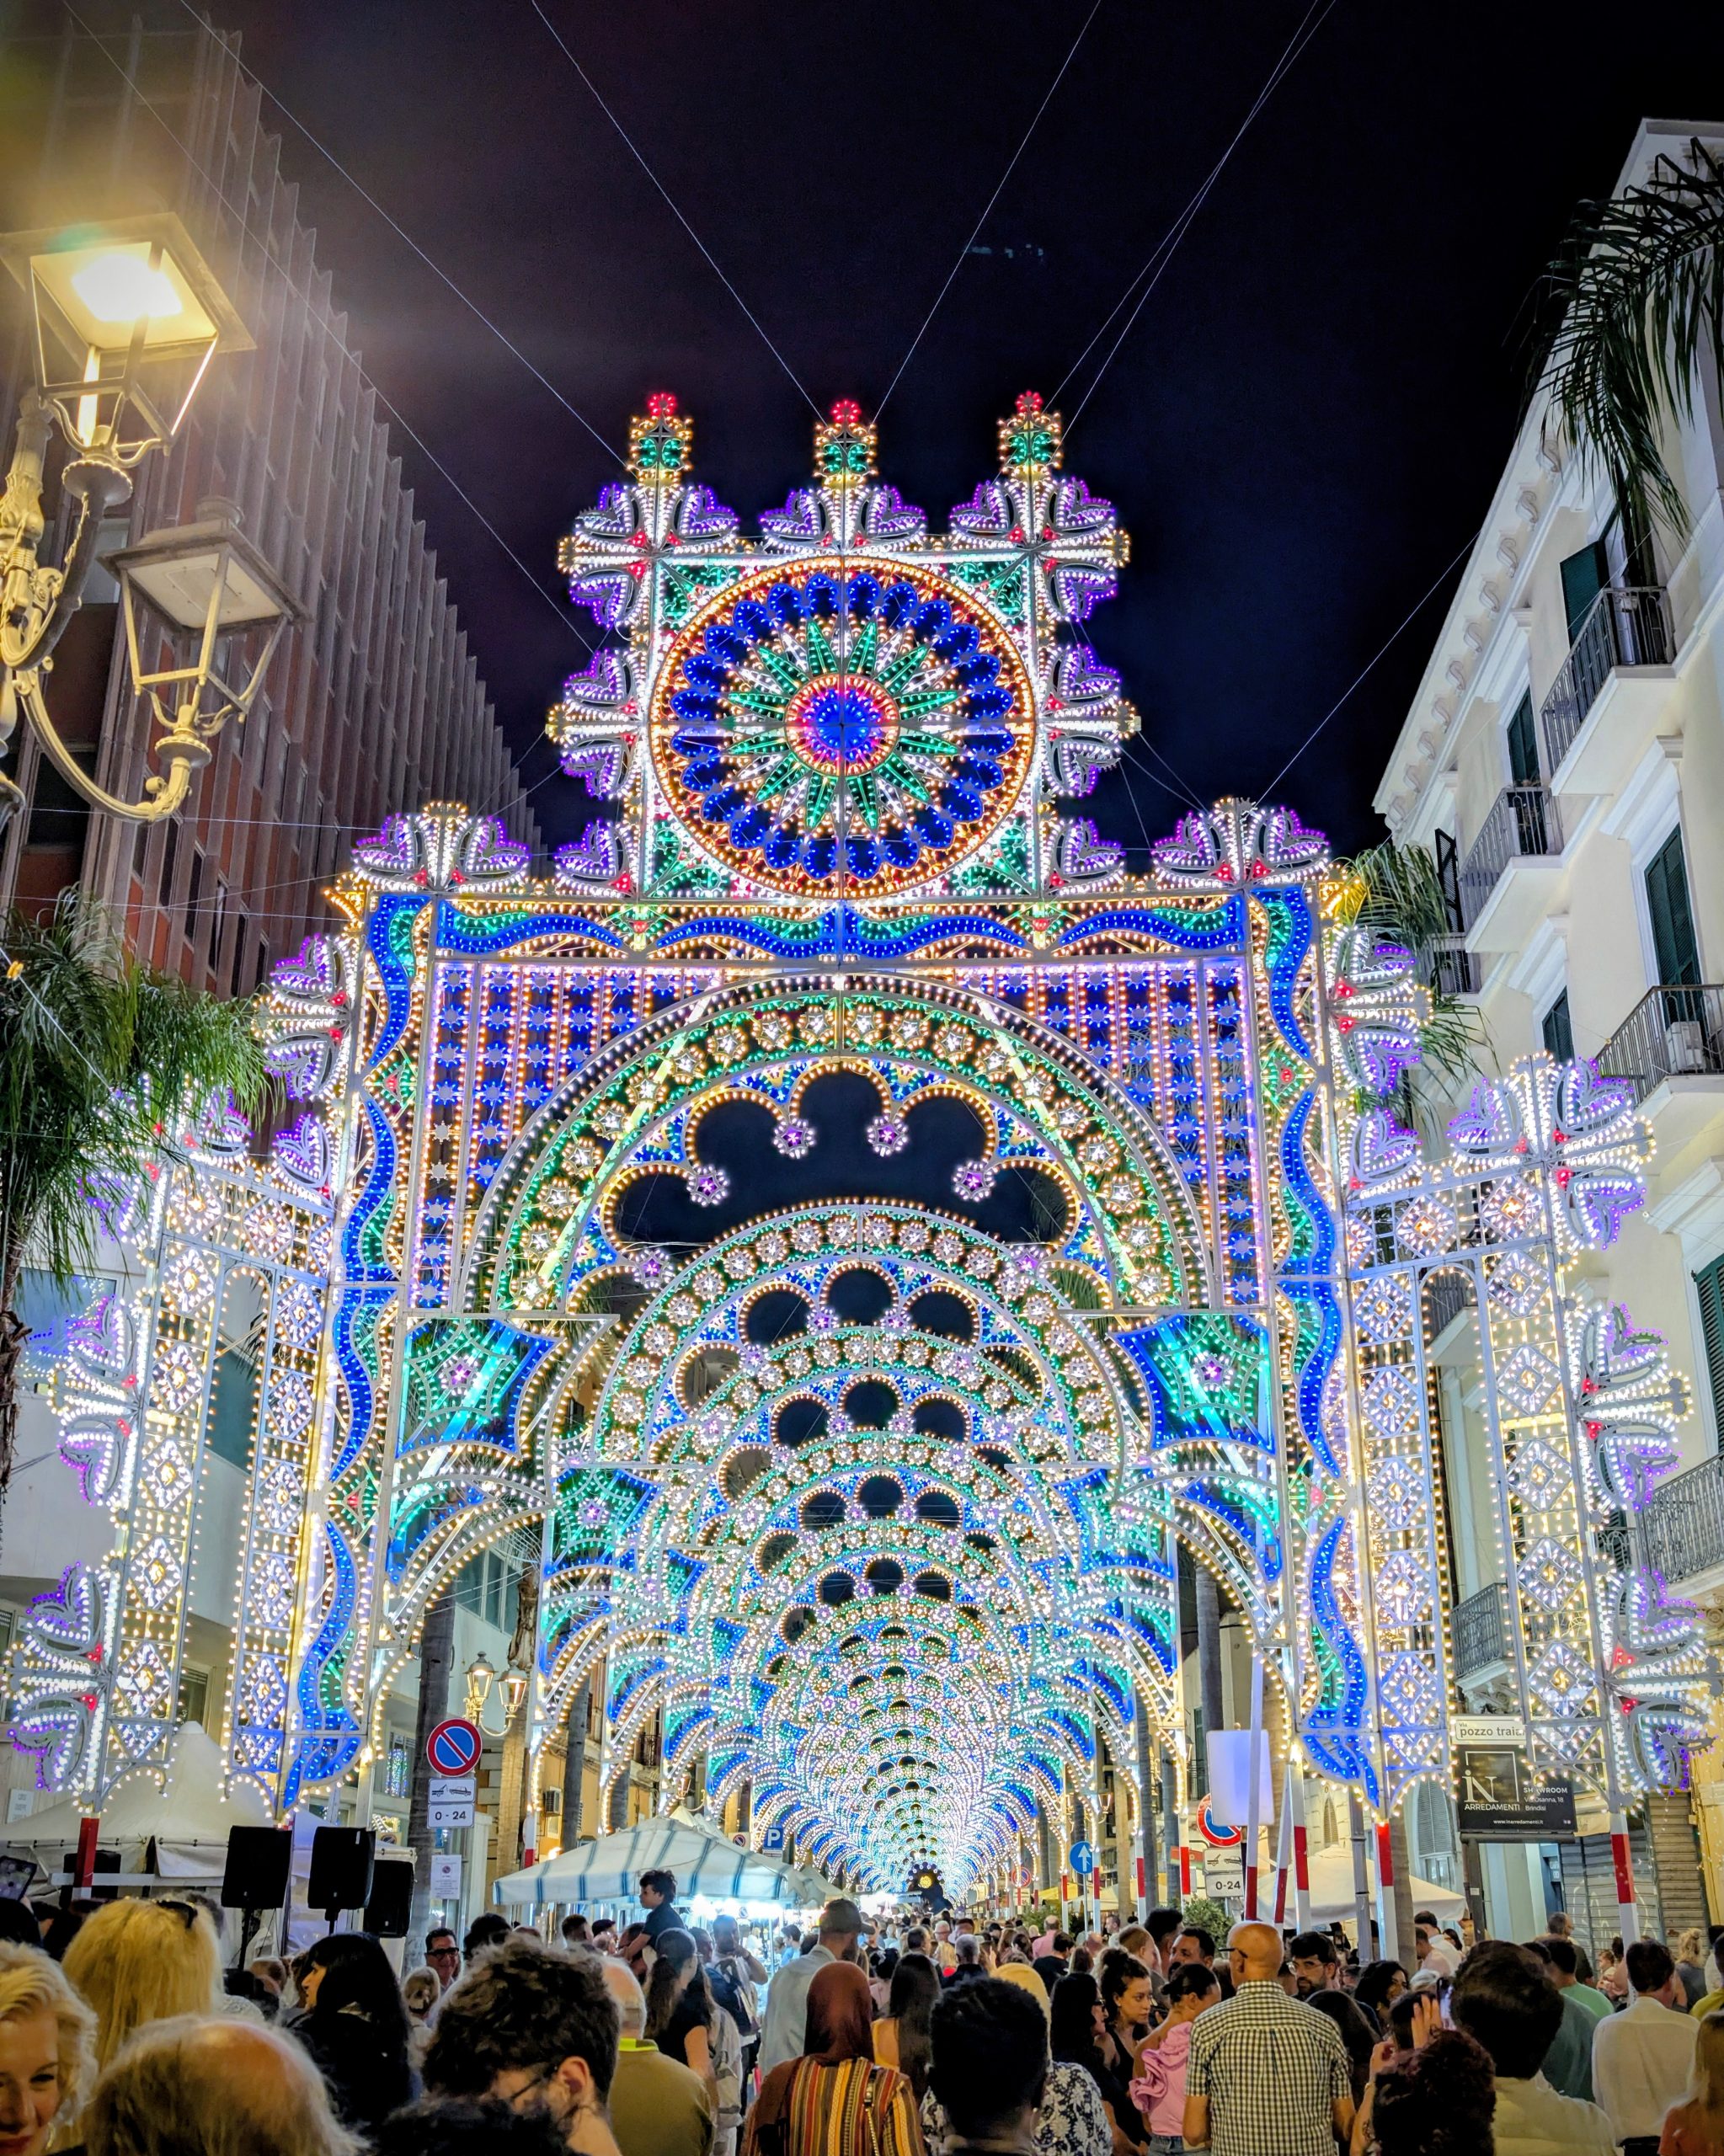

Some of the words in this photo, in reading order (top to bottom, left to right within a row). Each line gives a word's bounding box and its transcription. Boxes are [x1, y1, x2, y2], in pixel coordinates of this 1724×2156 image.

[1460, 1728, 1493, 1737] pozzo
[435, 1812, 442, 1820] 0
[452, 1811, 467, 1820] 24
[767, 1828, 781, 1846] P
[1215, 1881, 1241, 1890] 0-24
